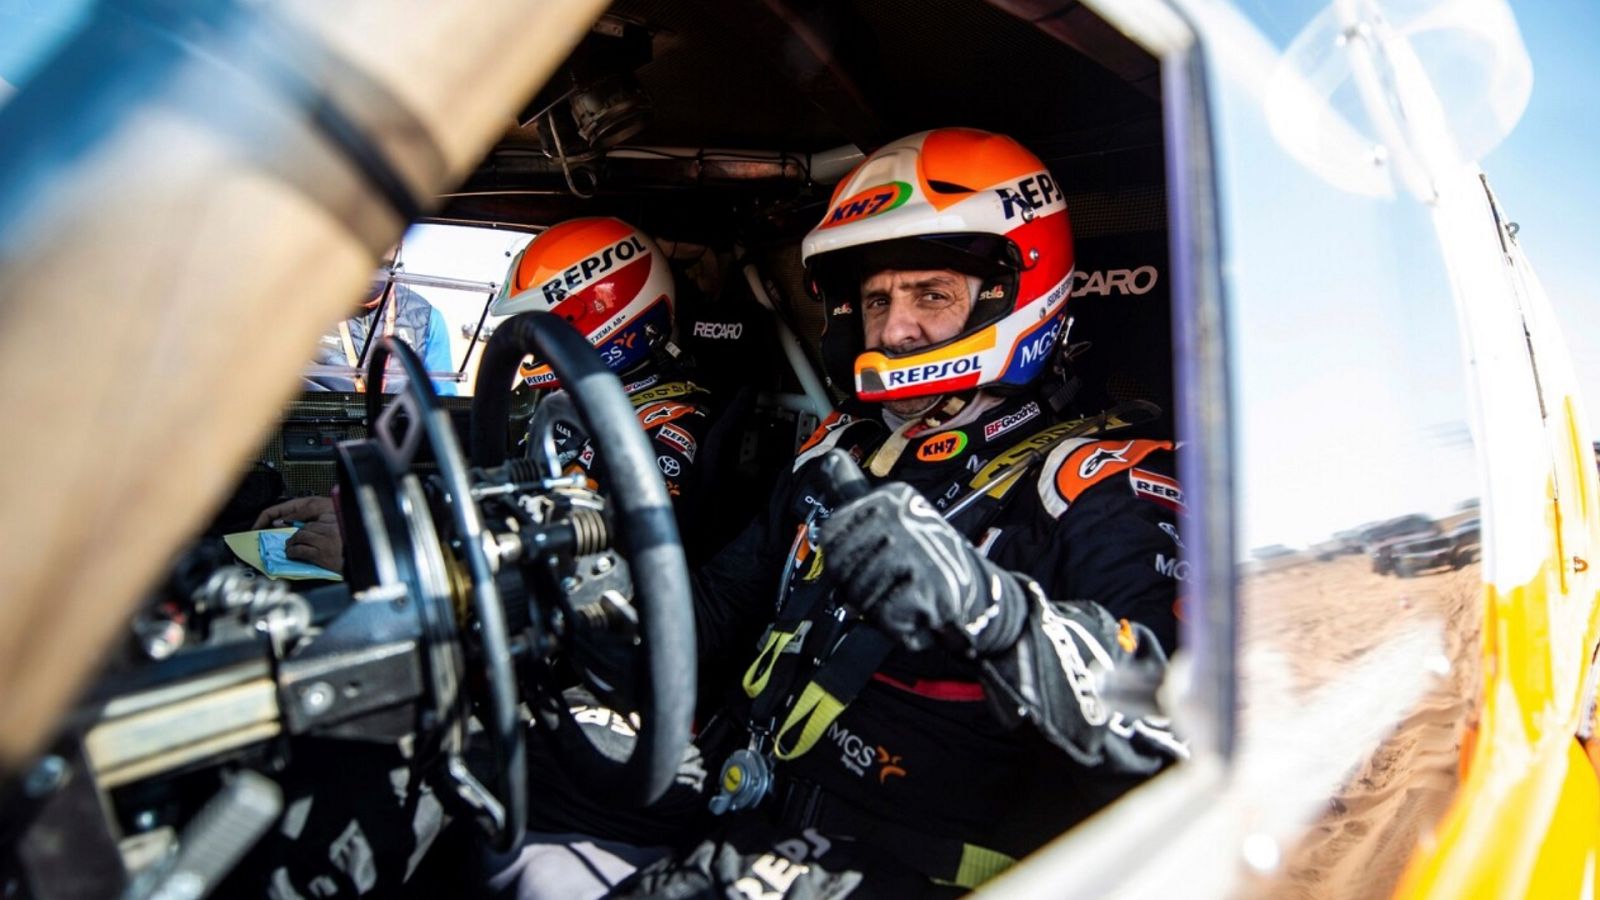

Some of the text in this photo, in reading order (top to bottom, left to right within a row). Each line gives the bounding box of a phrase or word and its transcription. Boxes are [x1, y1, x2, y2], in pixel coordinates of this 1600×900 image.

[542, 236, 646, 304] REPSOL
[693, 321, 742, 340] RECARO
[889, 355, 983, 386] REPSOL
[1154, 553, 1191, 581] MG
[827, 722, 876, 767] MGS
